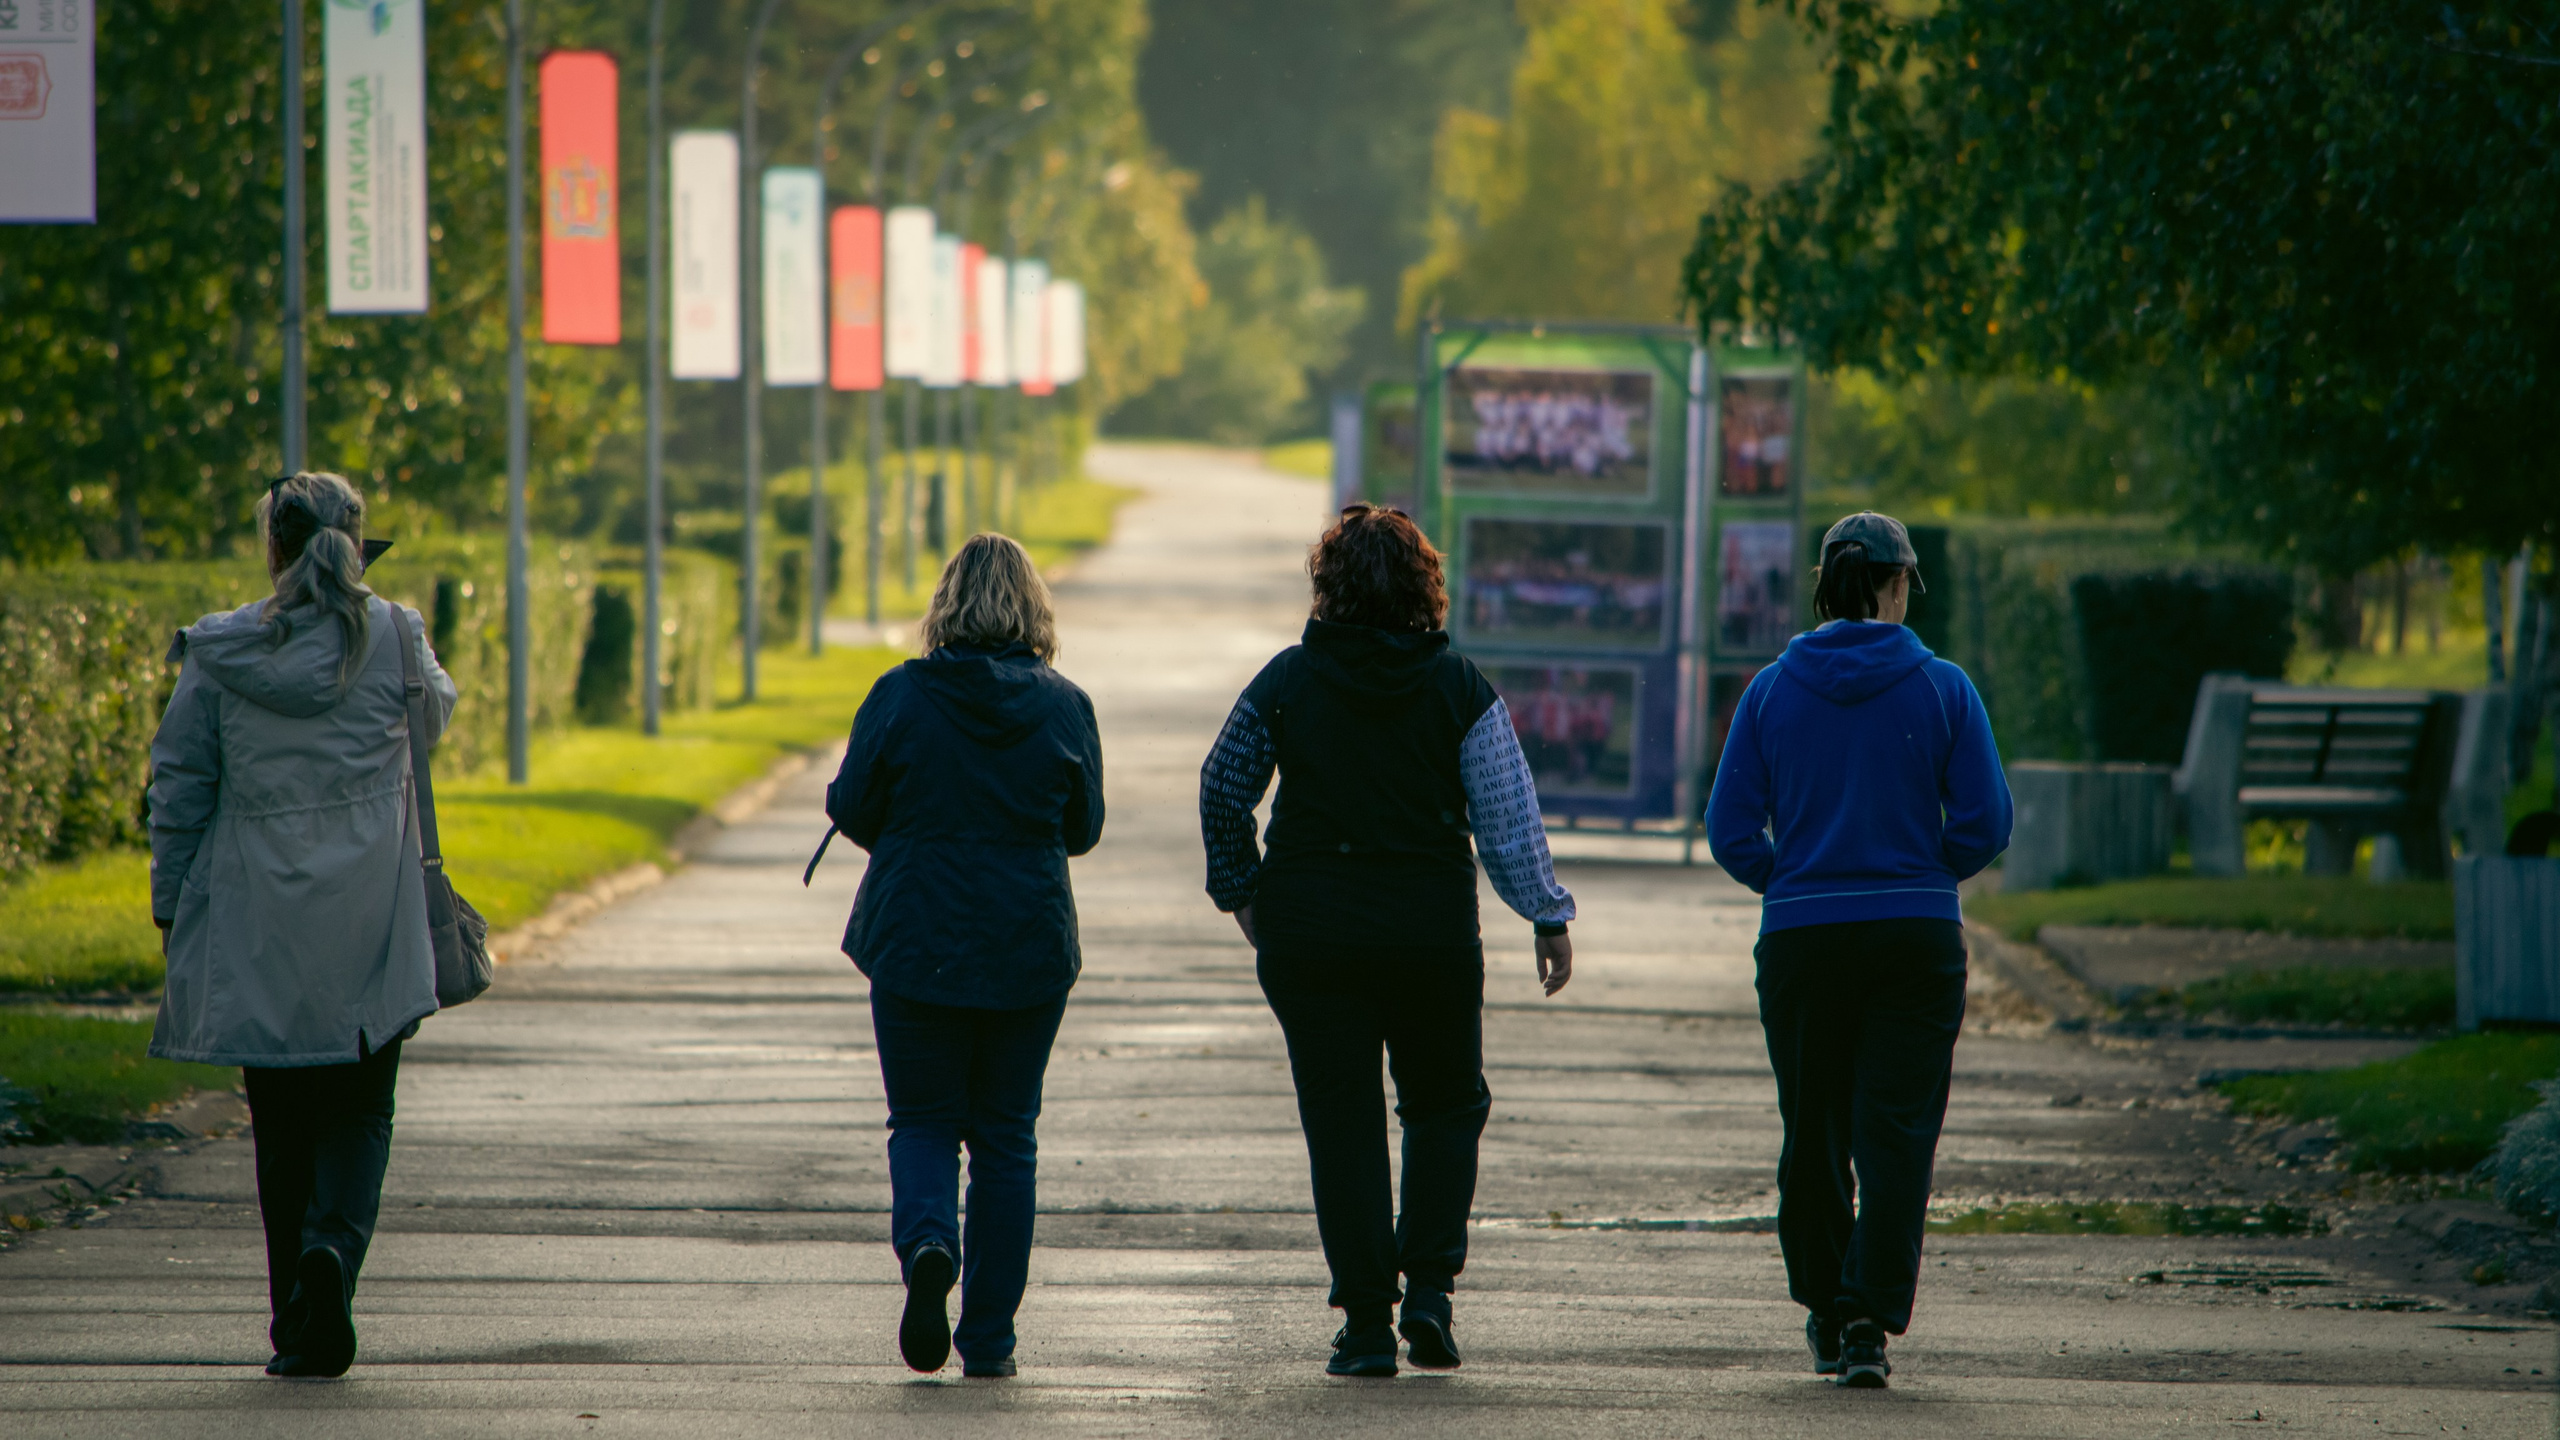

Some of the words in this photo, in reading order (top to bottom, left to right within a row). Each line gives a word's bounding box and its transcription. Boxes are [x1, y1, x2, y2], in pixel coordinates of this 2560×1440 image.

[62, 0, 78, 32] СО
[348, 75, 372, 291] СПАРТАКИАДА
[1483, 773, 1522, 793] ANGOLA
